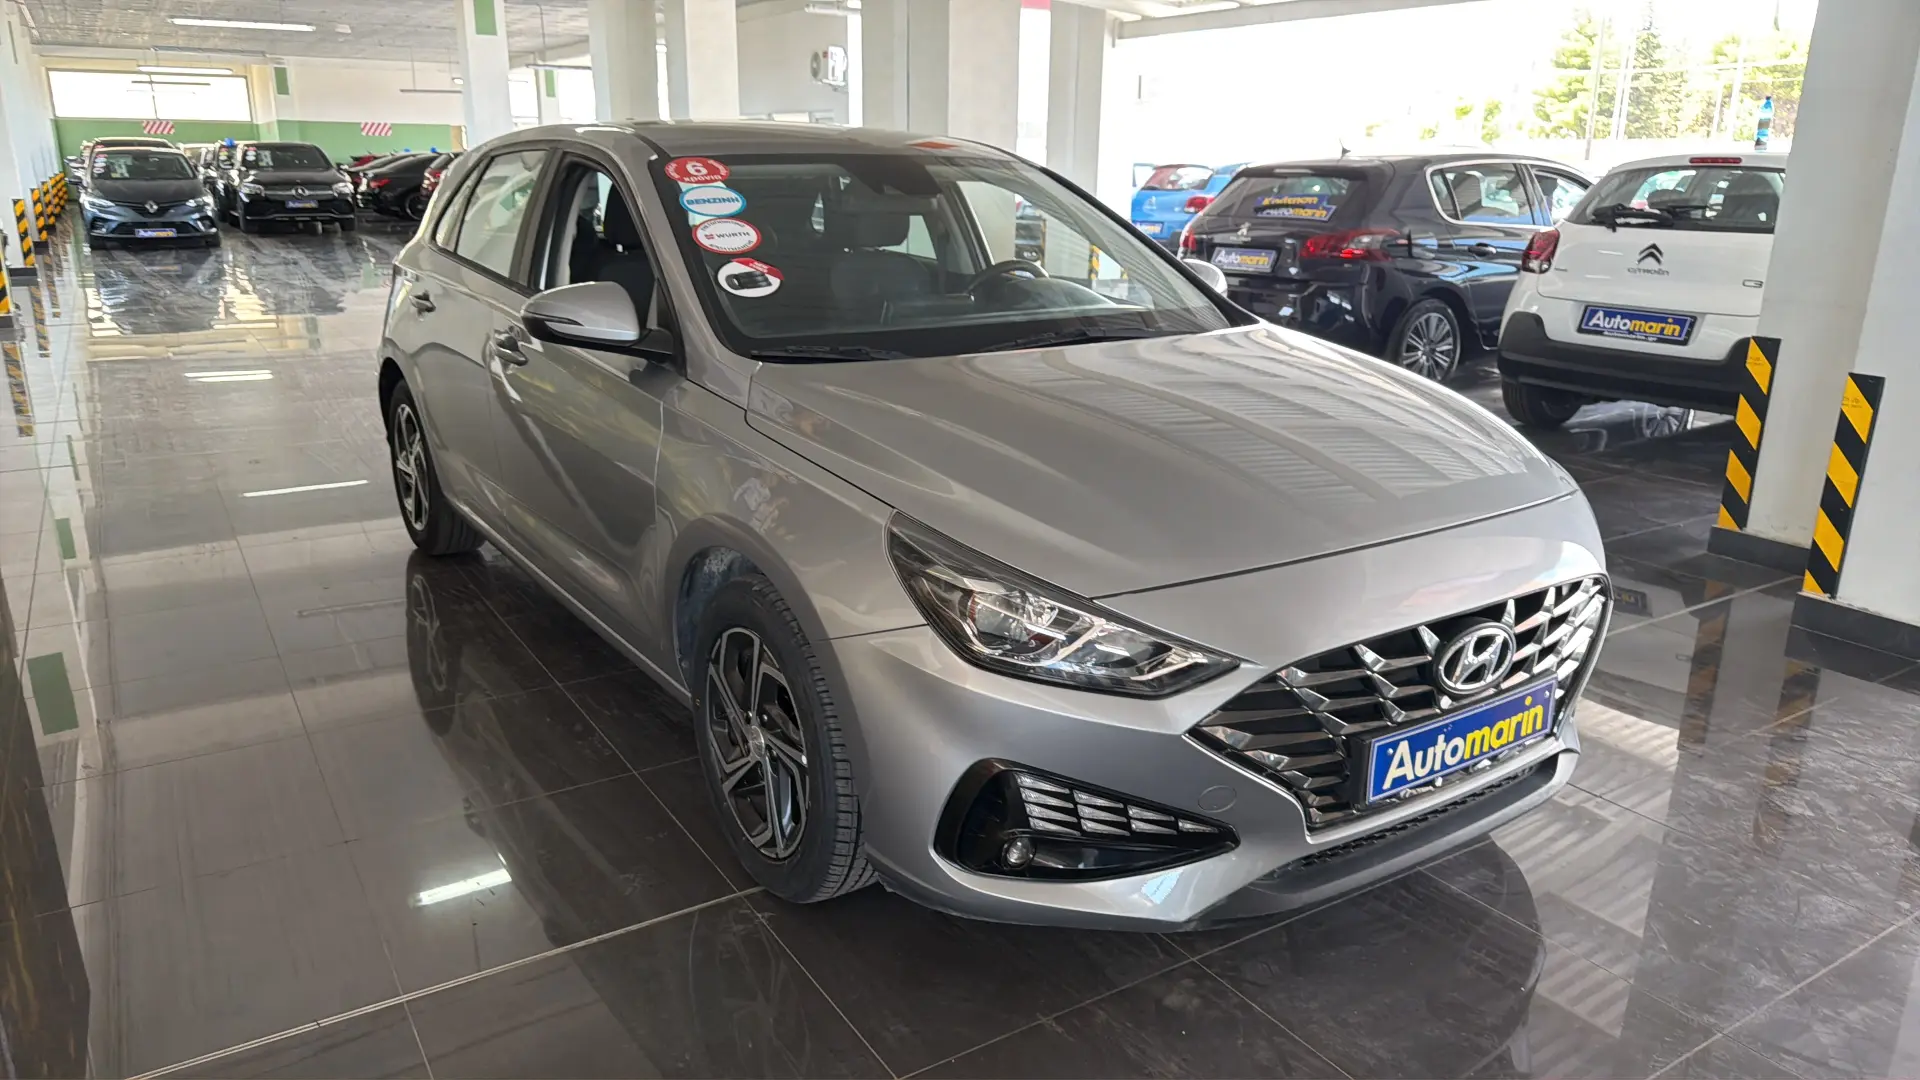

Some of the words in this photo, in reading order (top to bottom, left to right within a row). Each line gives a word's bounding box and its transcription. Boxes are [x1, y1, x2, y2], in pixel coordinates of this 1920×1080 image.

[686, 161, 708, 176] 6
[1742, 279, 1763, 289] C3
[1588, 310, 1680, 337] Automarin
[1382, 696, 1543, 790] Automarin
